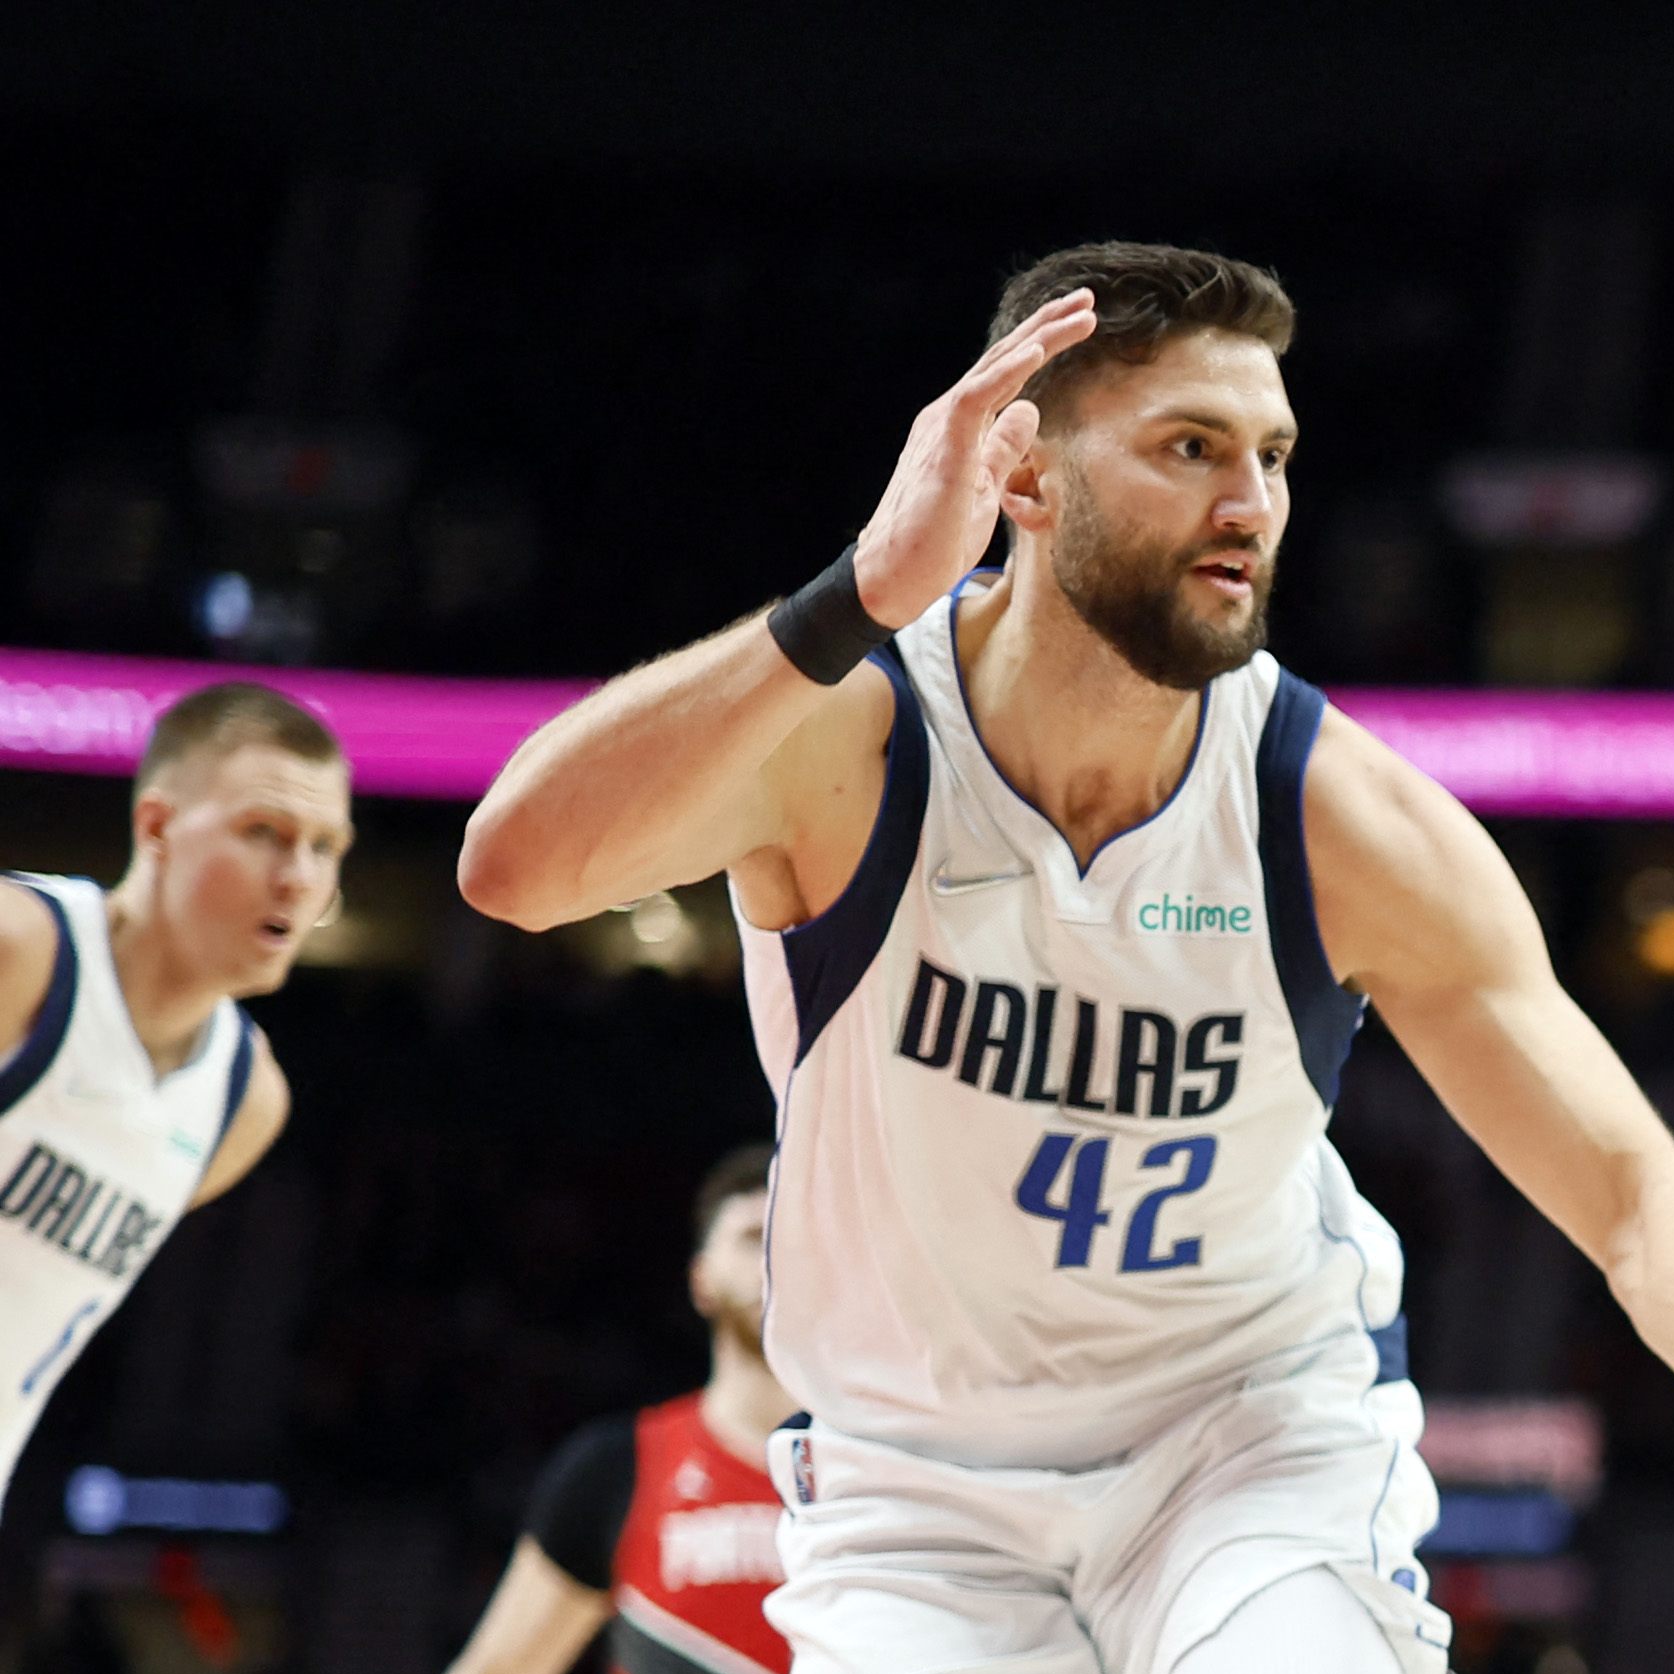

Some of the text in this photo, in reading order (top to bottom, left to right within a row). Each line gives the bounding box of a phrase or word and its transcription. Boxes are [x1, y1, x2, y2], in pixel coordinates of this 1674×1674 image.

[1138, 895, 1252, 933] chime
[895, 952, 1246, 1119] DALLAS
[1013, 1133, 1219, 1274] 42
